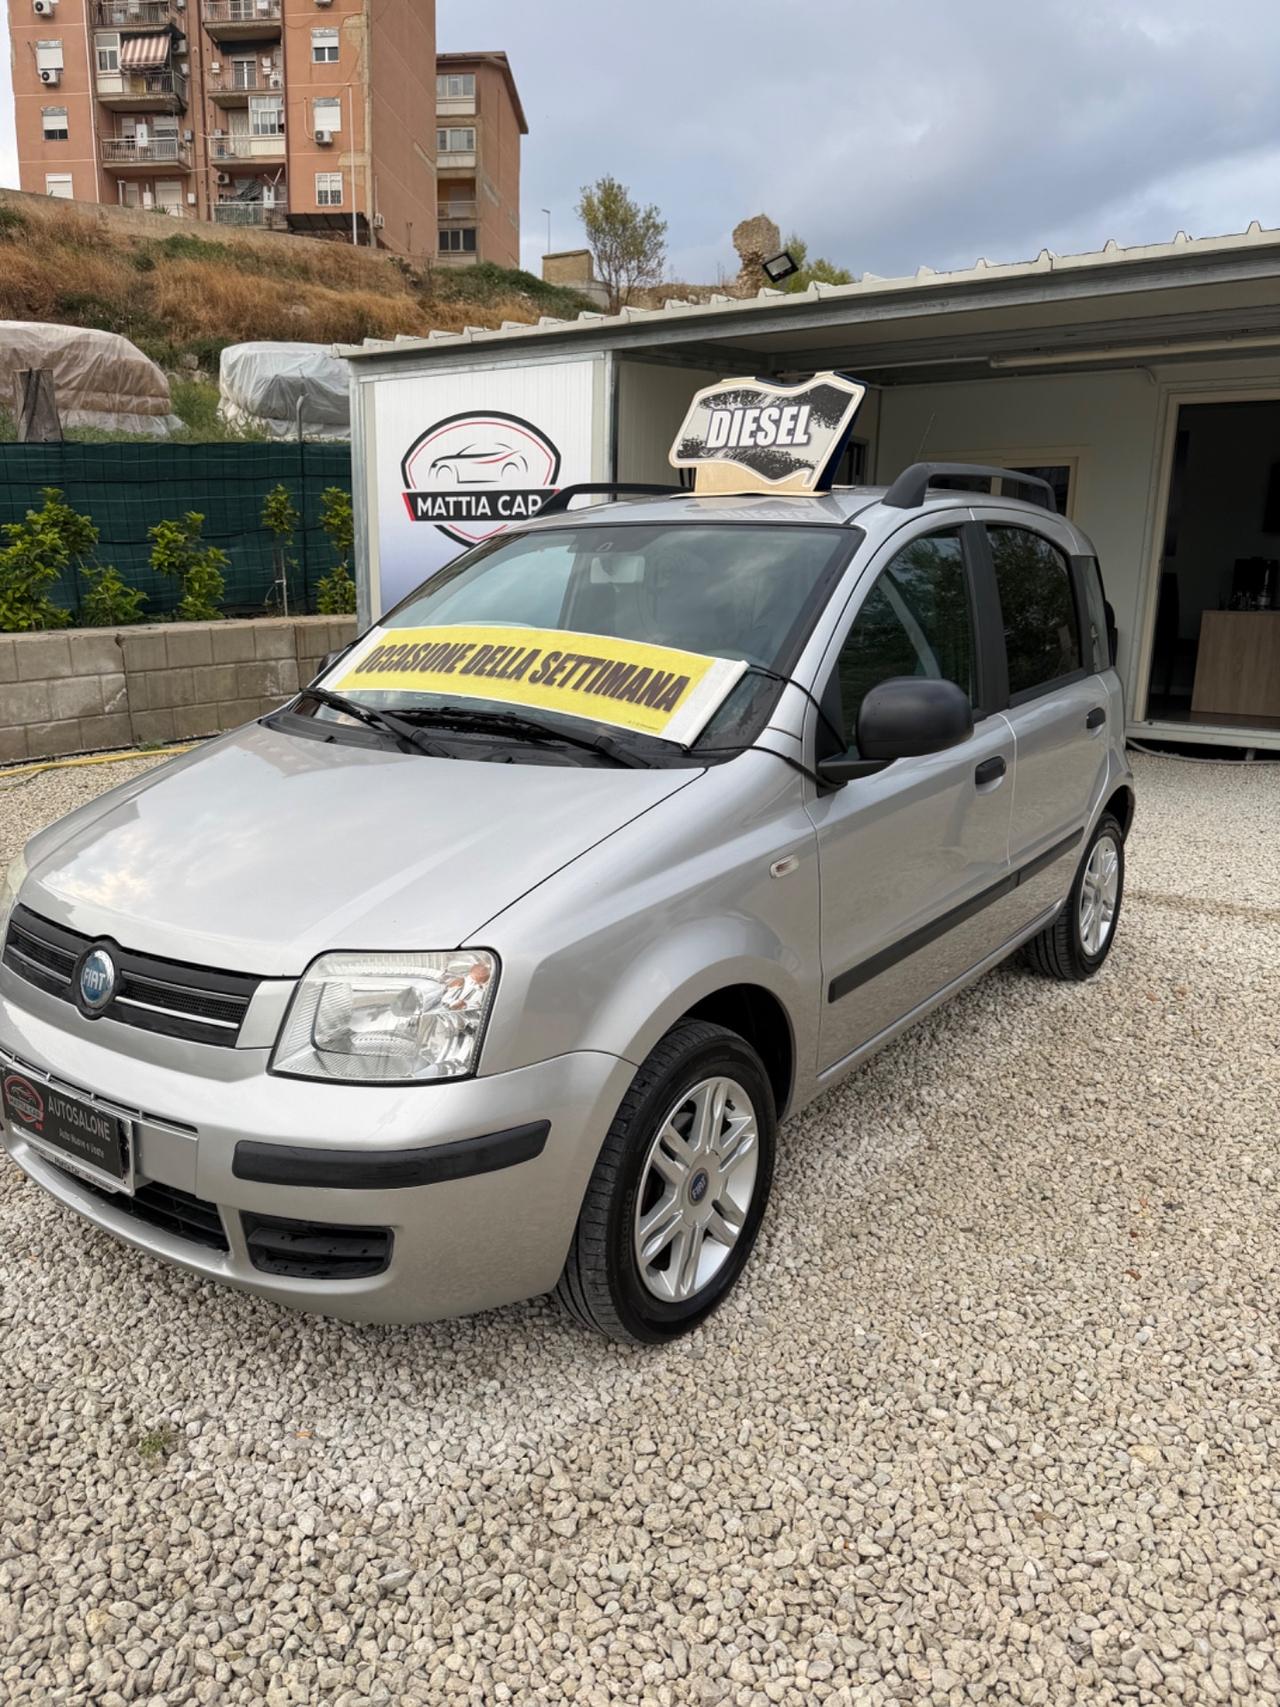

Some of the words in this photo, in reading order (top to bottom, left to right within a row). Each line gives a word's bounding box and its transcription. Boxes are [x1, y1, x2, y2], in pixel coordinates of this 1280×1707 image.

[706, 405, 811, 448] DIESEL
[417, 495, 491, 517] MATTIA
[355, 642, 473, 675] OCCASIONE
[463, 645, 533, 680] DELLA
[529, 650, 691, 713] SETTIMANA
[84, 967, 106, 991] FIAT
[48, 1095, 111, 1142] AUTOSALONE
